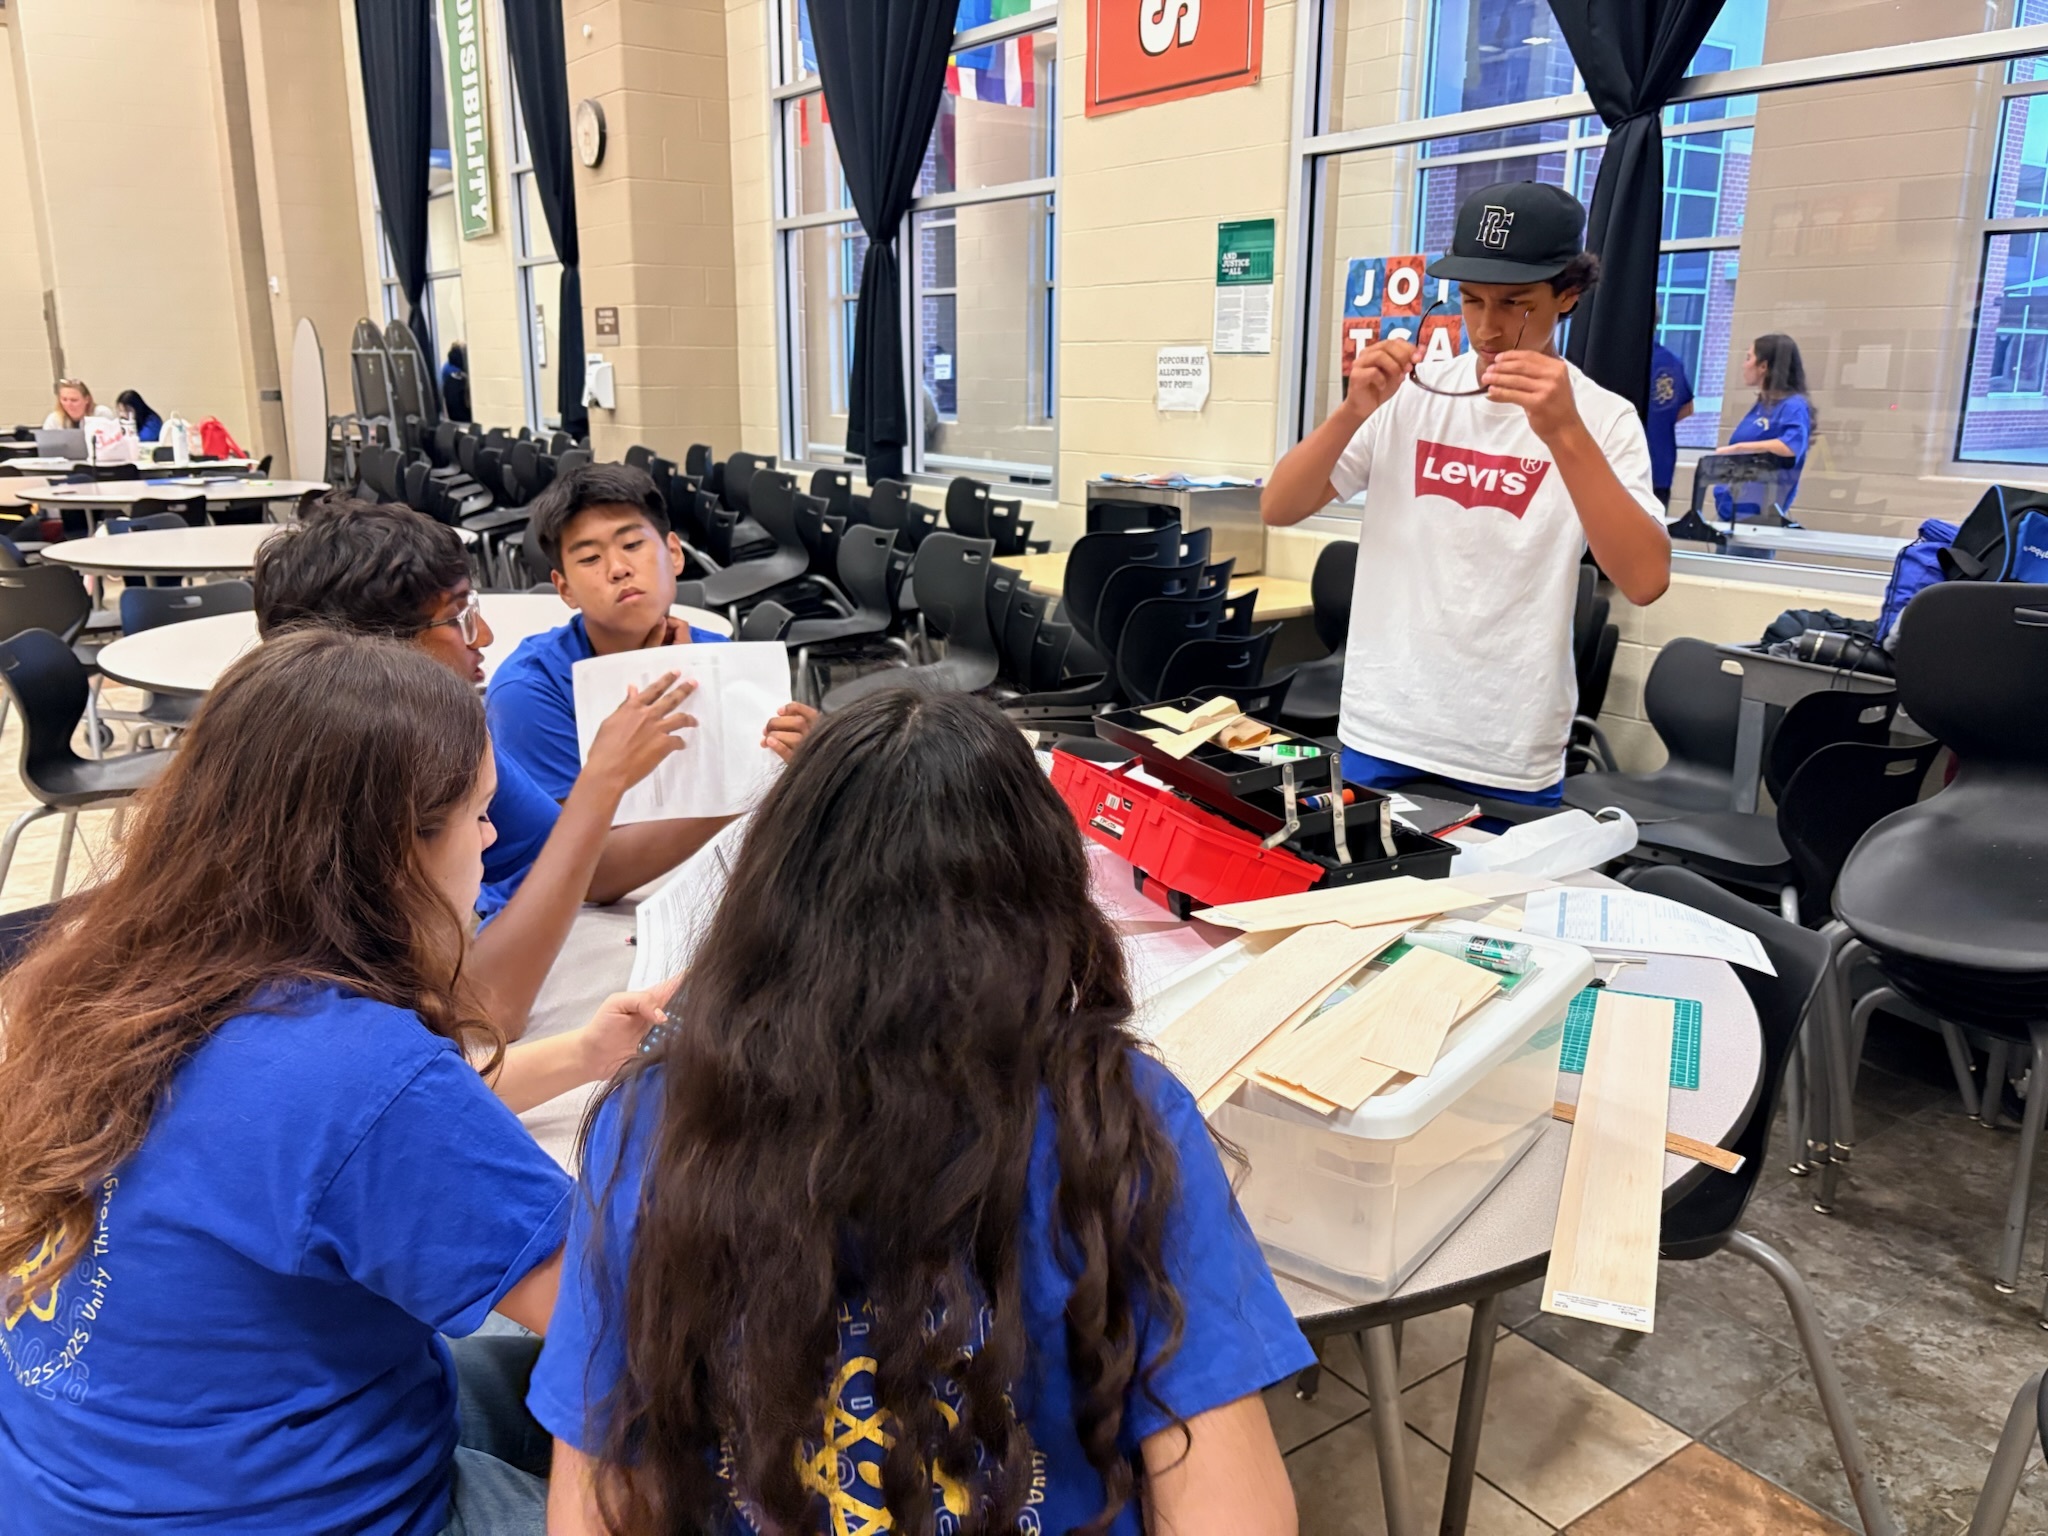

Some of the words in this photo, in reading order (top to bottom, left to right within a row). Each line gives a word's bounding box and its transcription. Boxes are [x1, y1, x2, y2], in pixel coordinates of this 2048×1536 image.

[1476, 205, 1514, 250] PG
[1222, 252, 1237, 260] AND
[1222, 258, 1251, 268] JUSTICE
[1228, 267, 1243, 275] ALL
[1159, 356, 1189, 364] POPCORN
[1159, 380, 1172, 388] NOT
[93, 1172, 119, 1256] Throug
[81, 1267, 112, 1321] Unity
